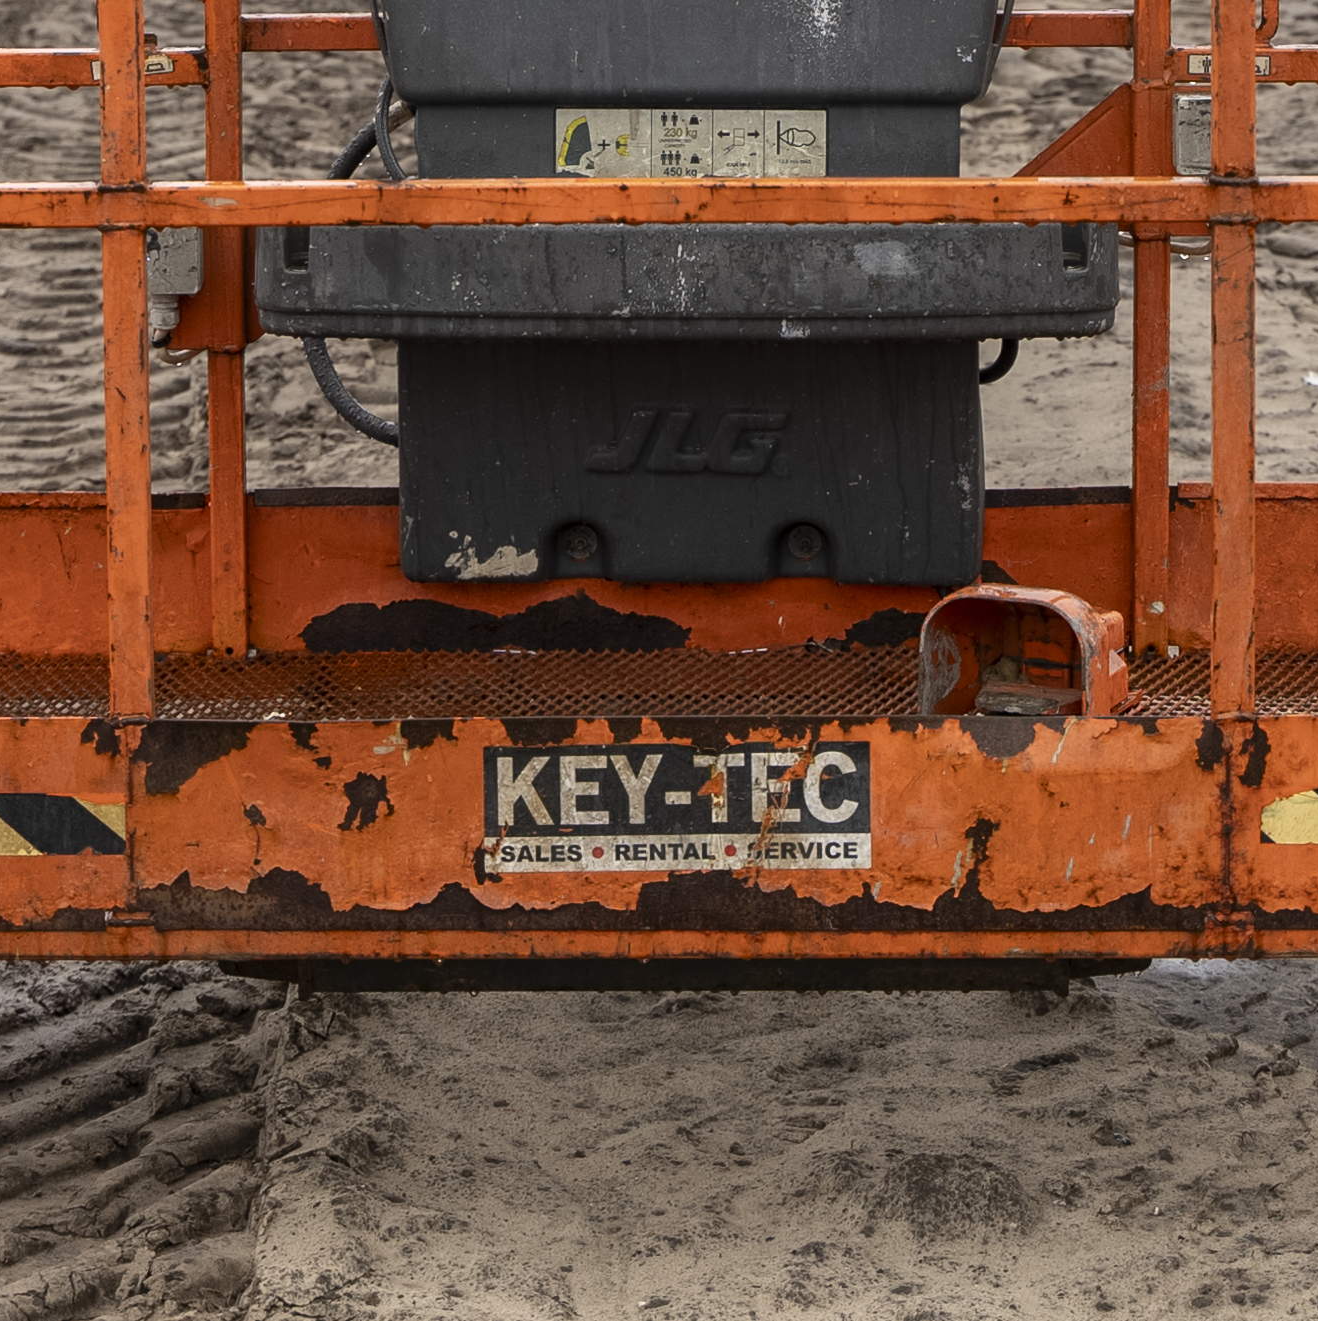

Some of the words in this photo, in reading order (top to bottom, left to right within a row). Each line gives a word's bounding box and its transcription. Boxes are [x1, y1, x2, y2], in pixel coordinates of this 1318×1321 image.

[663, 127, 683, 138] 230
[685, 127, 698, 140] kg
[663, 166, 683, 177] 450
[685, 167, 698, 178] kg
[584, 405, 788, 473] JLG
[496, 750, 860, 826] KEY-TEC
[500, 843, 583, 863] SALES
[614, 841, 716, 862] RENTAL
[746, 840, 859, 861] SERVICE
